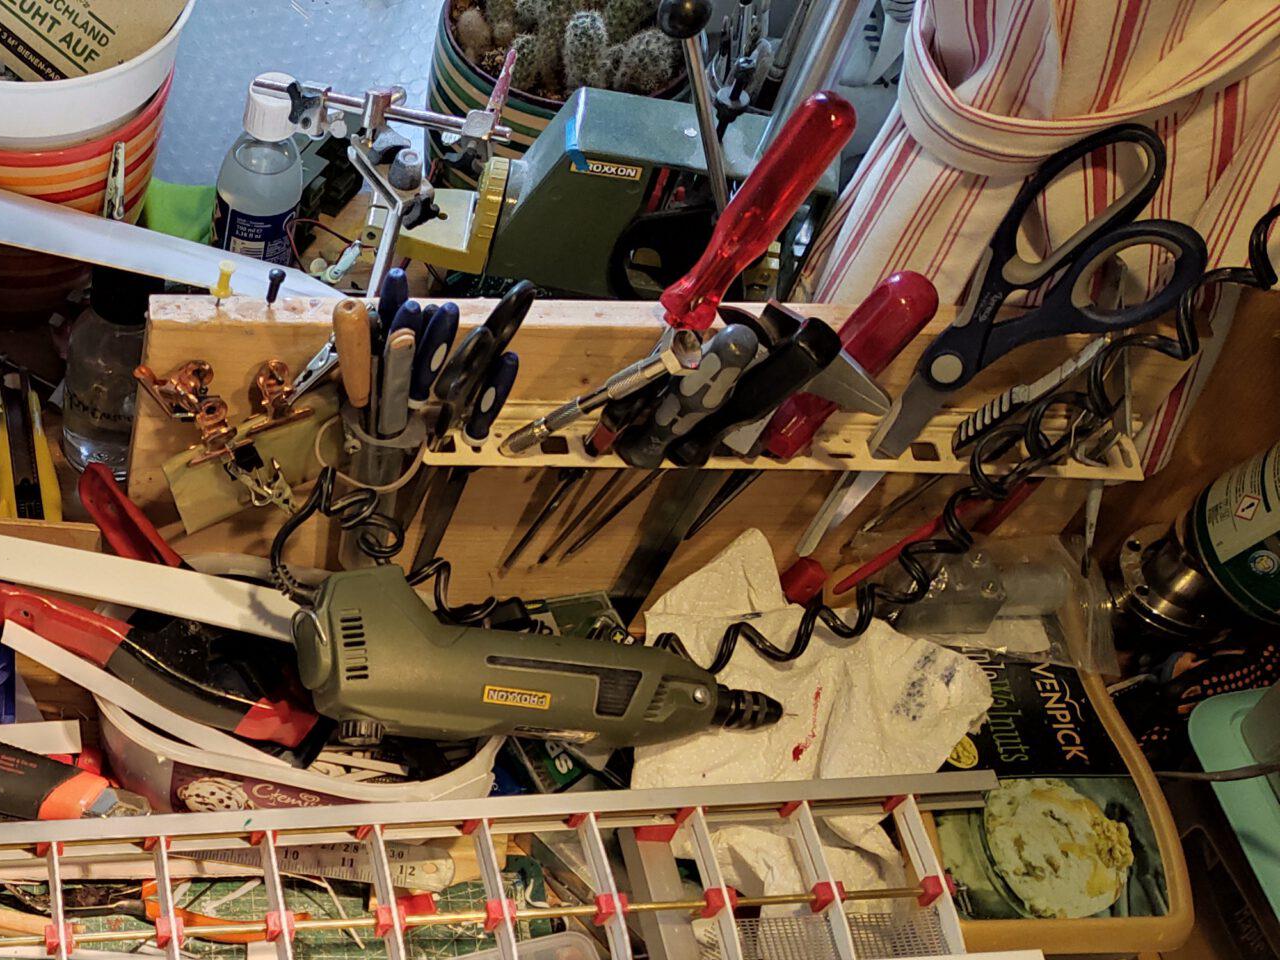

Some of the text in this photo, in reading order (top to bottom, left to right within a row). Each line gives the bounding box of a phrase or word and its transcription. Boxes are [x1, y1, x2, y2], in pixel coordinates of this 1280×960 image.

[59, 31, 101, 64] AUF
[488, 690, 547, 706] PROXXON
[343, 843, 360, 854] 28
[283, 847, 416, 876] 10 11 12
